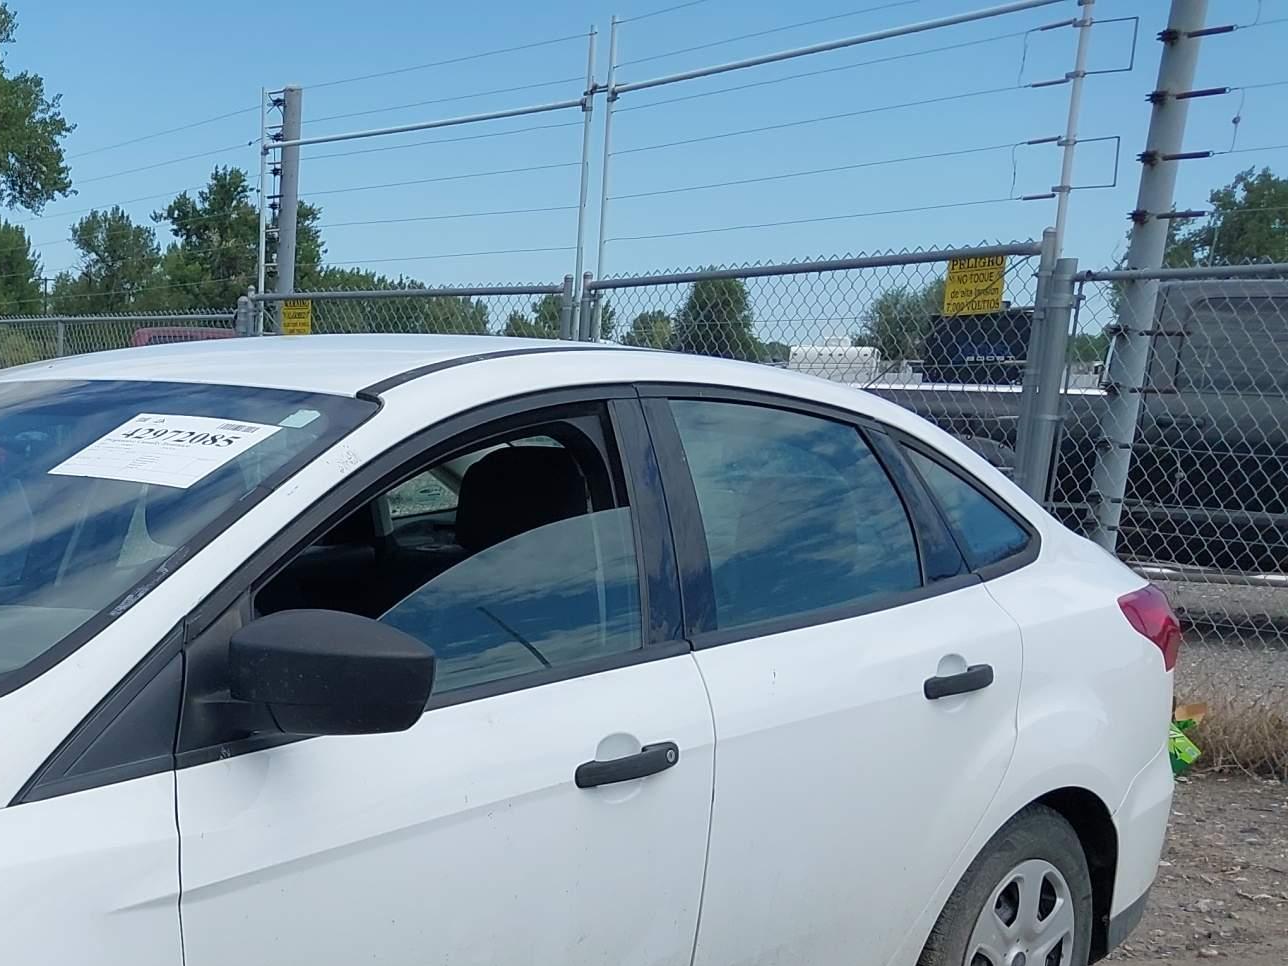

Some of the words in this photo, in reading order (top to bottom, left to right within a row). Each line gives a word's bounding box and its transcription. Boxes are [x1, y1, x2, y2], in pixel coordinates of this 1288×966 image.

[951, 256, 1004, 271] PELIGRO
[970, 271, 994, 284] TOQUE
[121, 427, 241, 448] 42972085
